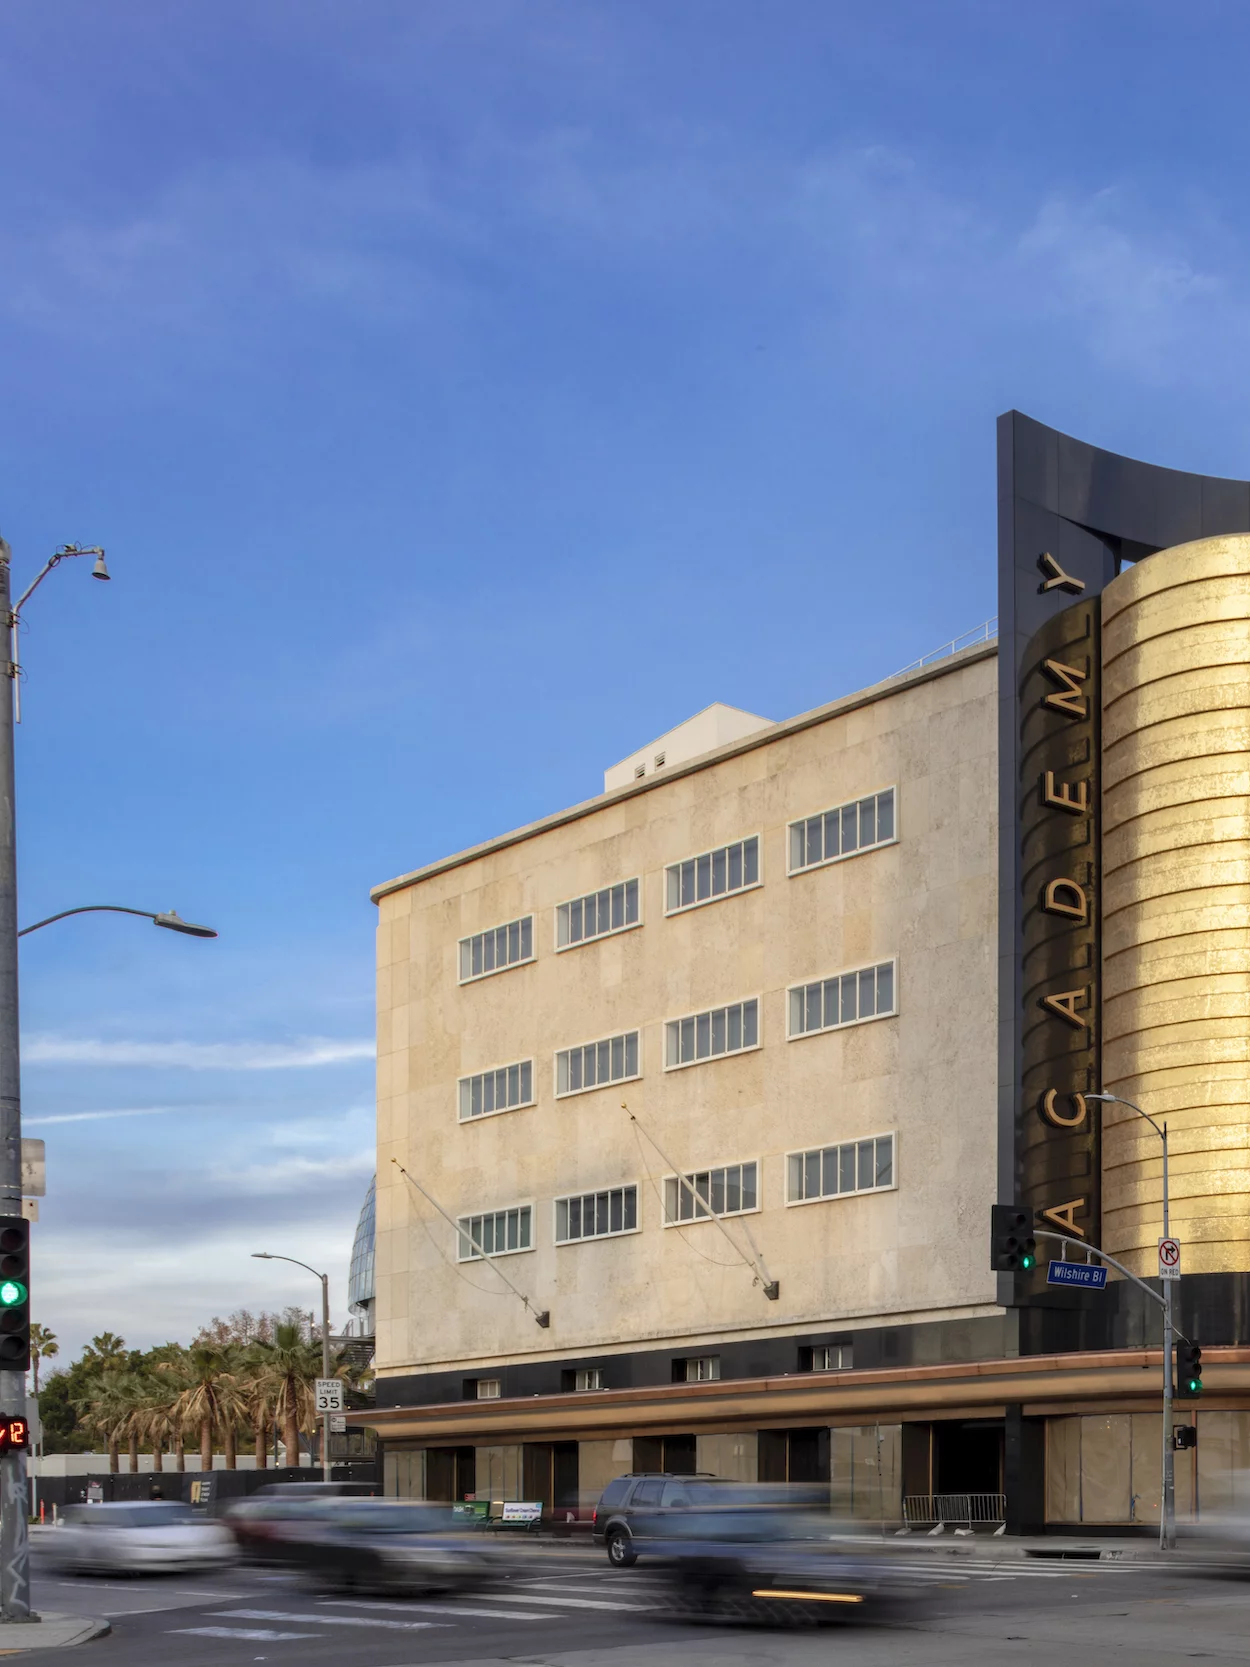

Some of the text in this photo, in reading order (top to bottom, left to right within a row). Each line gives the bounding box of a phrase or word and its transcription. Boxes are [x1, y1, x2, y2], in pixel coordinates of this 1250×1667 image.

[1038, 551, 1088, 1237] ACADEMY
[1054, 1266, 1103, 1283] Wilshire Bl
[1161, 1268, 1179, 1276] ON RED
[319, 1396, 340, 1409] 35
[10, 1422, 24, 1443] 12
